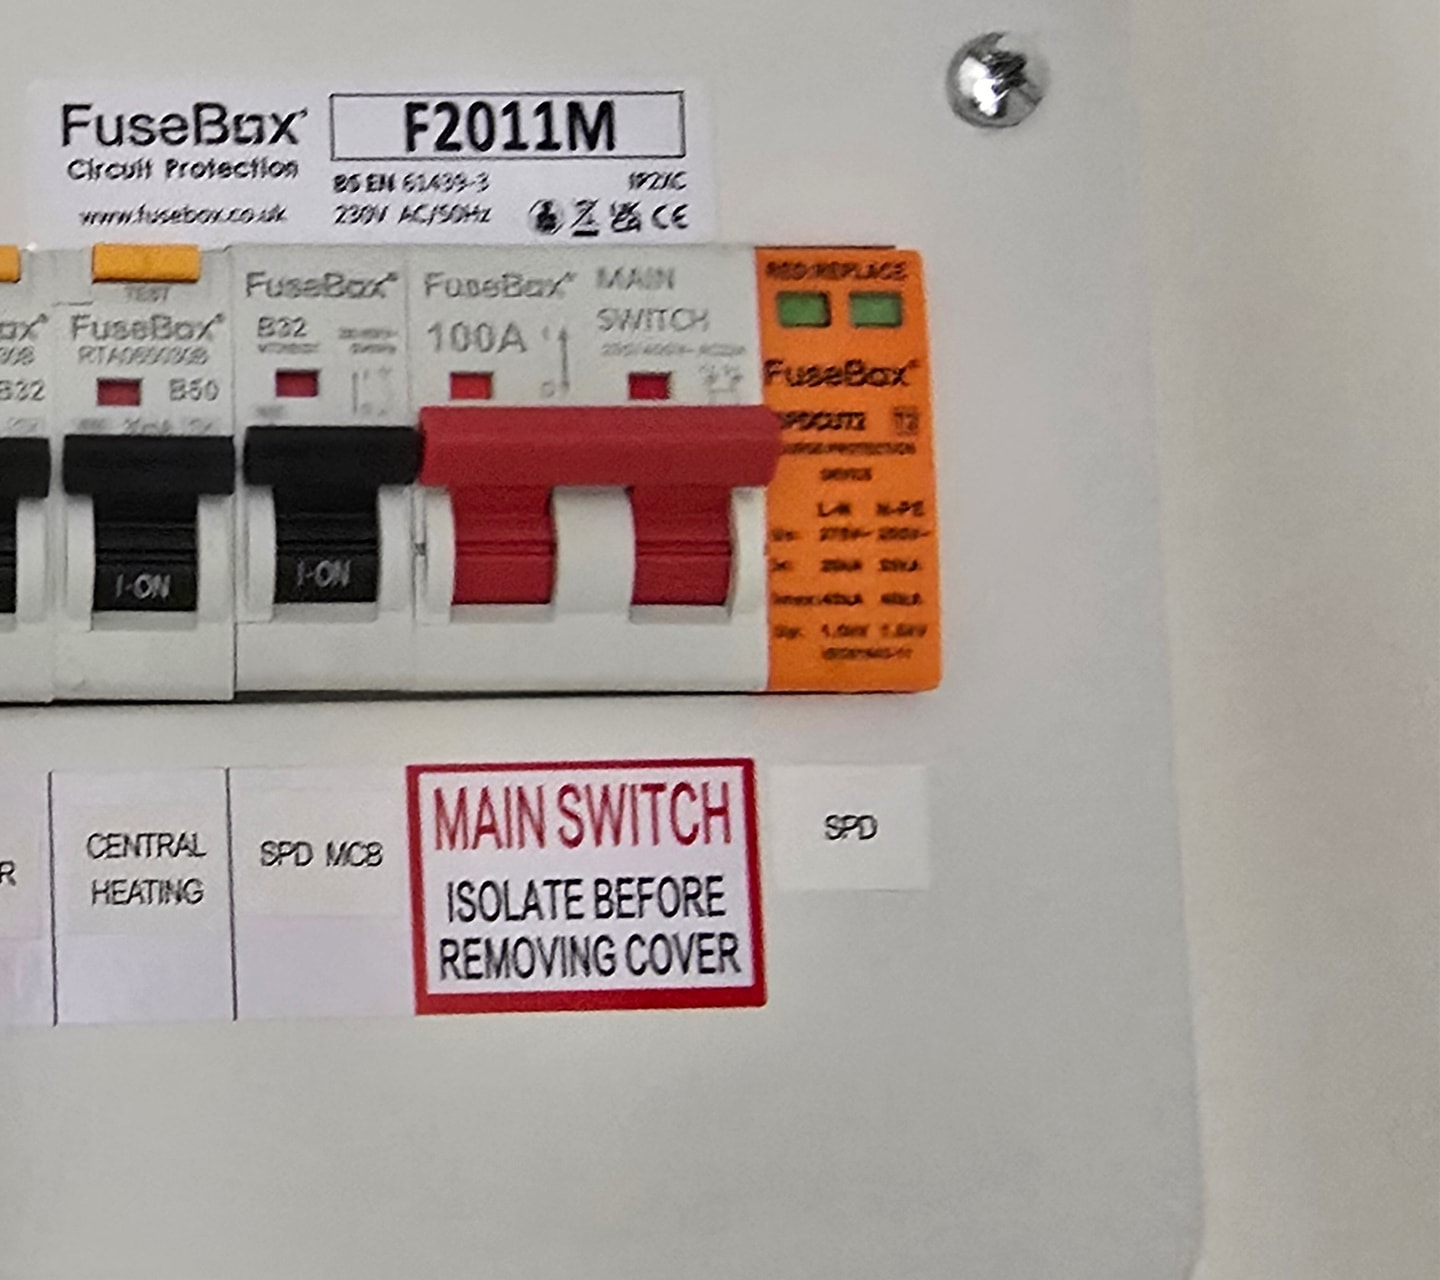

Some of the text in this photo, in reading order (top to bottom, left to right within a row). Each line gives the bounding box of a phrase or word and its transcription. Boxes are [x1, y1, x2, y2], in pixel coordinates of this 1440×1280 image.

[405, 100, 616, 152] F2011M
[66, 157, 300, 181] Circuit Protection
[333, 173, 361, 194] BS
[365, 172, 396, 193] EN
[78, 203, 289, 226] www.fusebox.co.uk
[333, 204, 392, 226] 230V
[596, 266, 676, 290] MAIN
[257, 316, 308, 338] B32
[596, 307, 710, 333] SWITCH
[427, 321, 528, 354] 100A
[168, 378, 220, 402] B50
[432, 780, 733, 851] MAIN SWITCH
[824, 814, 878, 840] SPD
[86, 831, 208, 860] CENTRAL
[259, 839, 384, 867] SPD MCB
[90, 877, 205, 907] HEATING
[446, 874, 728, 924] ISOLATE BEFORE
[438, 930, 743, 982] REMOVING COVER
